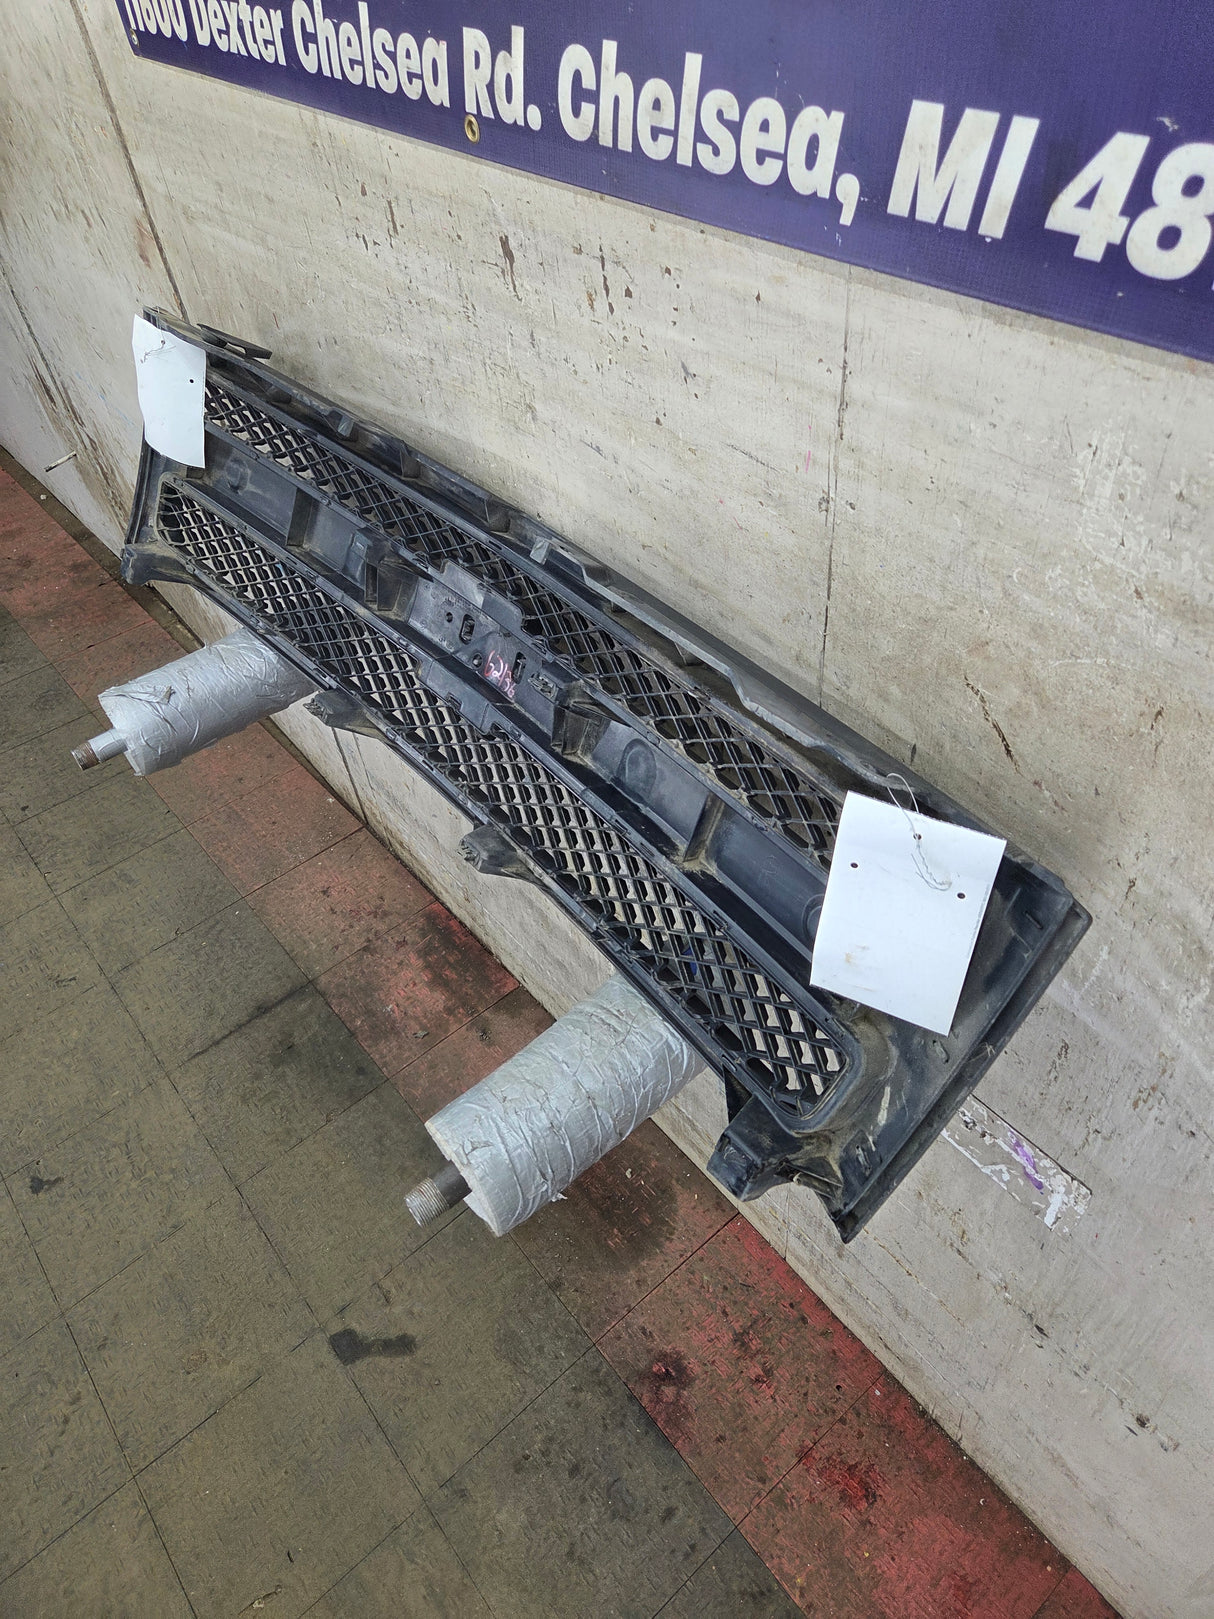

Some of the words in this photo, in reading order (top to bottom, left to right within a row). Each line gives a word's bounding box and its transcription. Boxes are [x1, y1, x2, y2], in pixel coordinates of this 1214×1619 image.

[189, 0, 287, 66] Dexter
[292, 0, 451, 109] Chelsea
[462, 25, 542, 132] Rd.
[557, 39, 862, 228] Chelsea,
[887, 99, 1041, 240] MI
